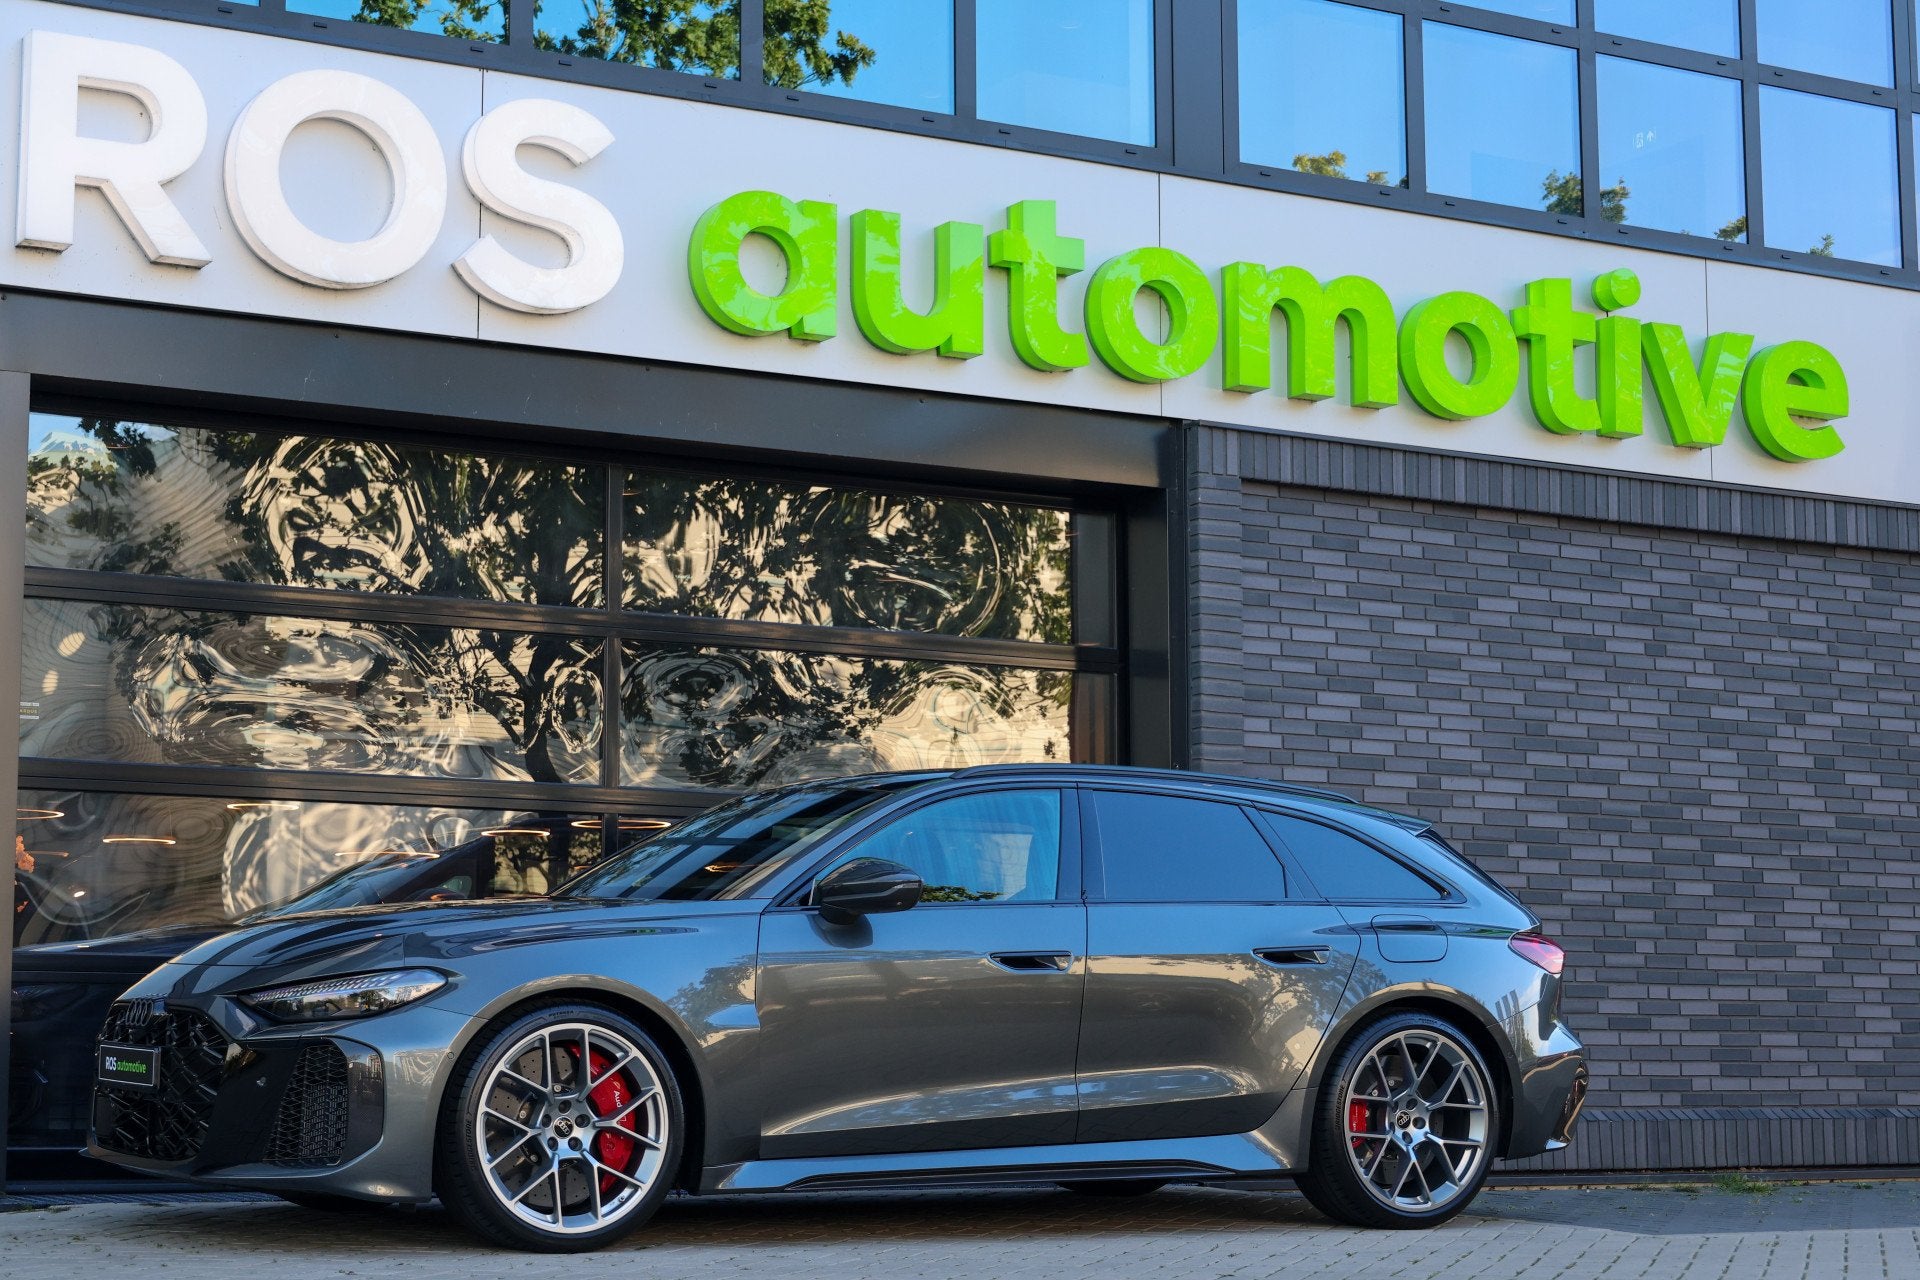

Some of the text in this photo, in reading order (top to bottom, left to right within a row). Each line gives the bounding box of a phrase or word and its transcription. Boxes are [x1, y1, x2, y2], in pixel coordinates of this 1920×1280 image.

[15, 29, 1849, 463] ROS automotive
[105, 1056, 147, 1073] ROS automotive
[613, 1090, 623, 1108] Aud
